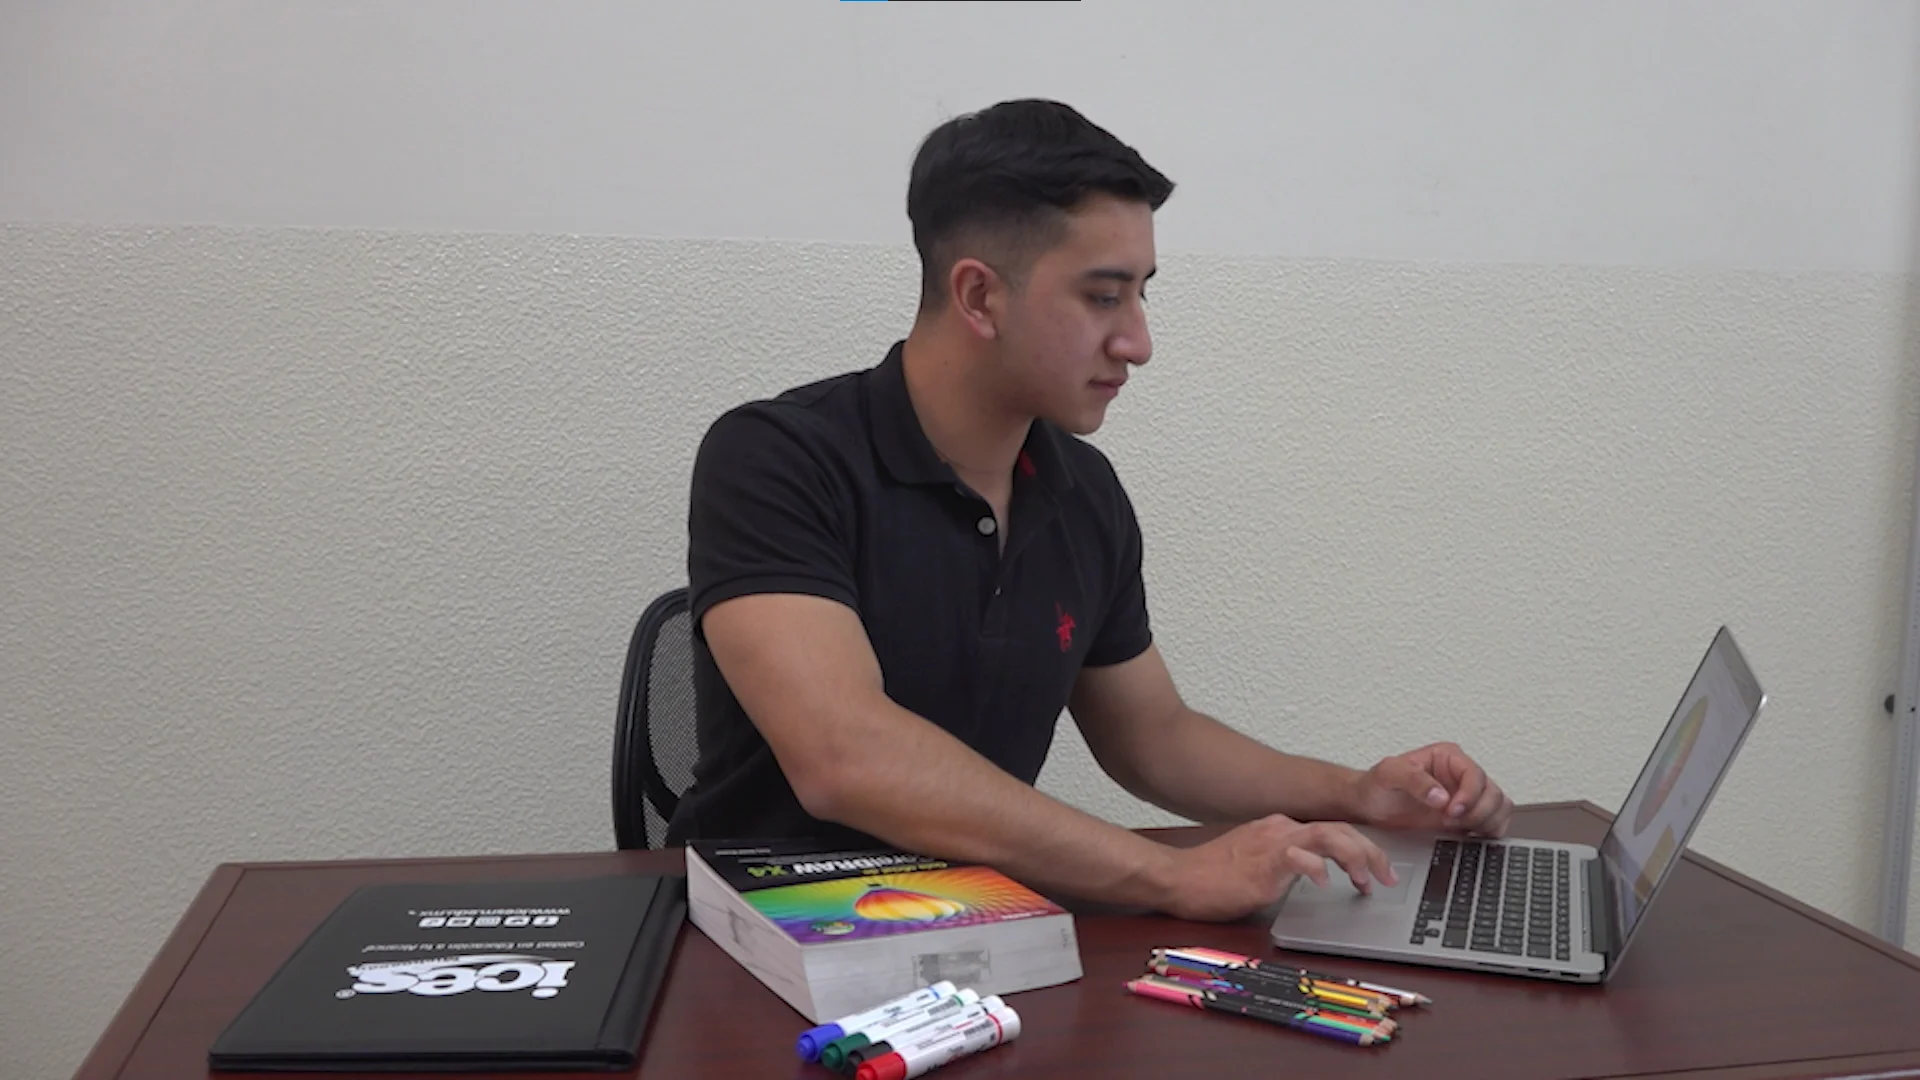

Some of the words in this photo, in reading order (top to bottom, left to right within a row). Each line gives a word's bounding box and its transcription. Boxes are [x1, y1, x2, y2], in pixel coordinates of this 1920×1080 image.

[747, 864, 788, 878] X4
[517, 941, 535, 950] en
[347, 956, 577, 999] ices
